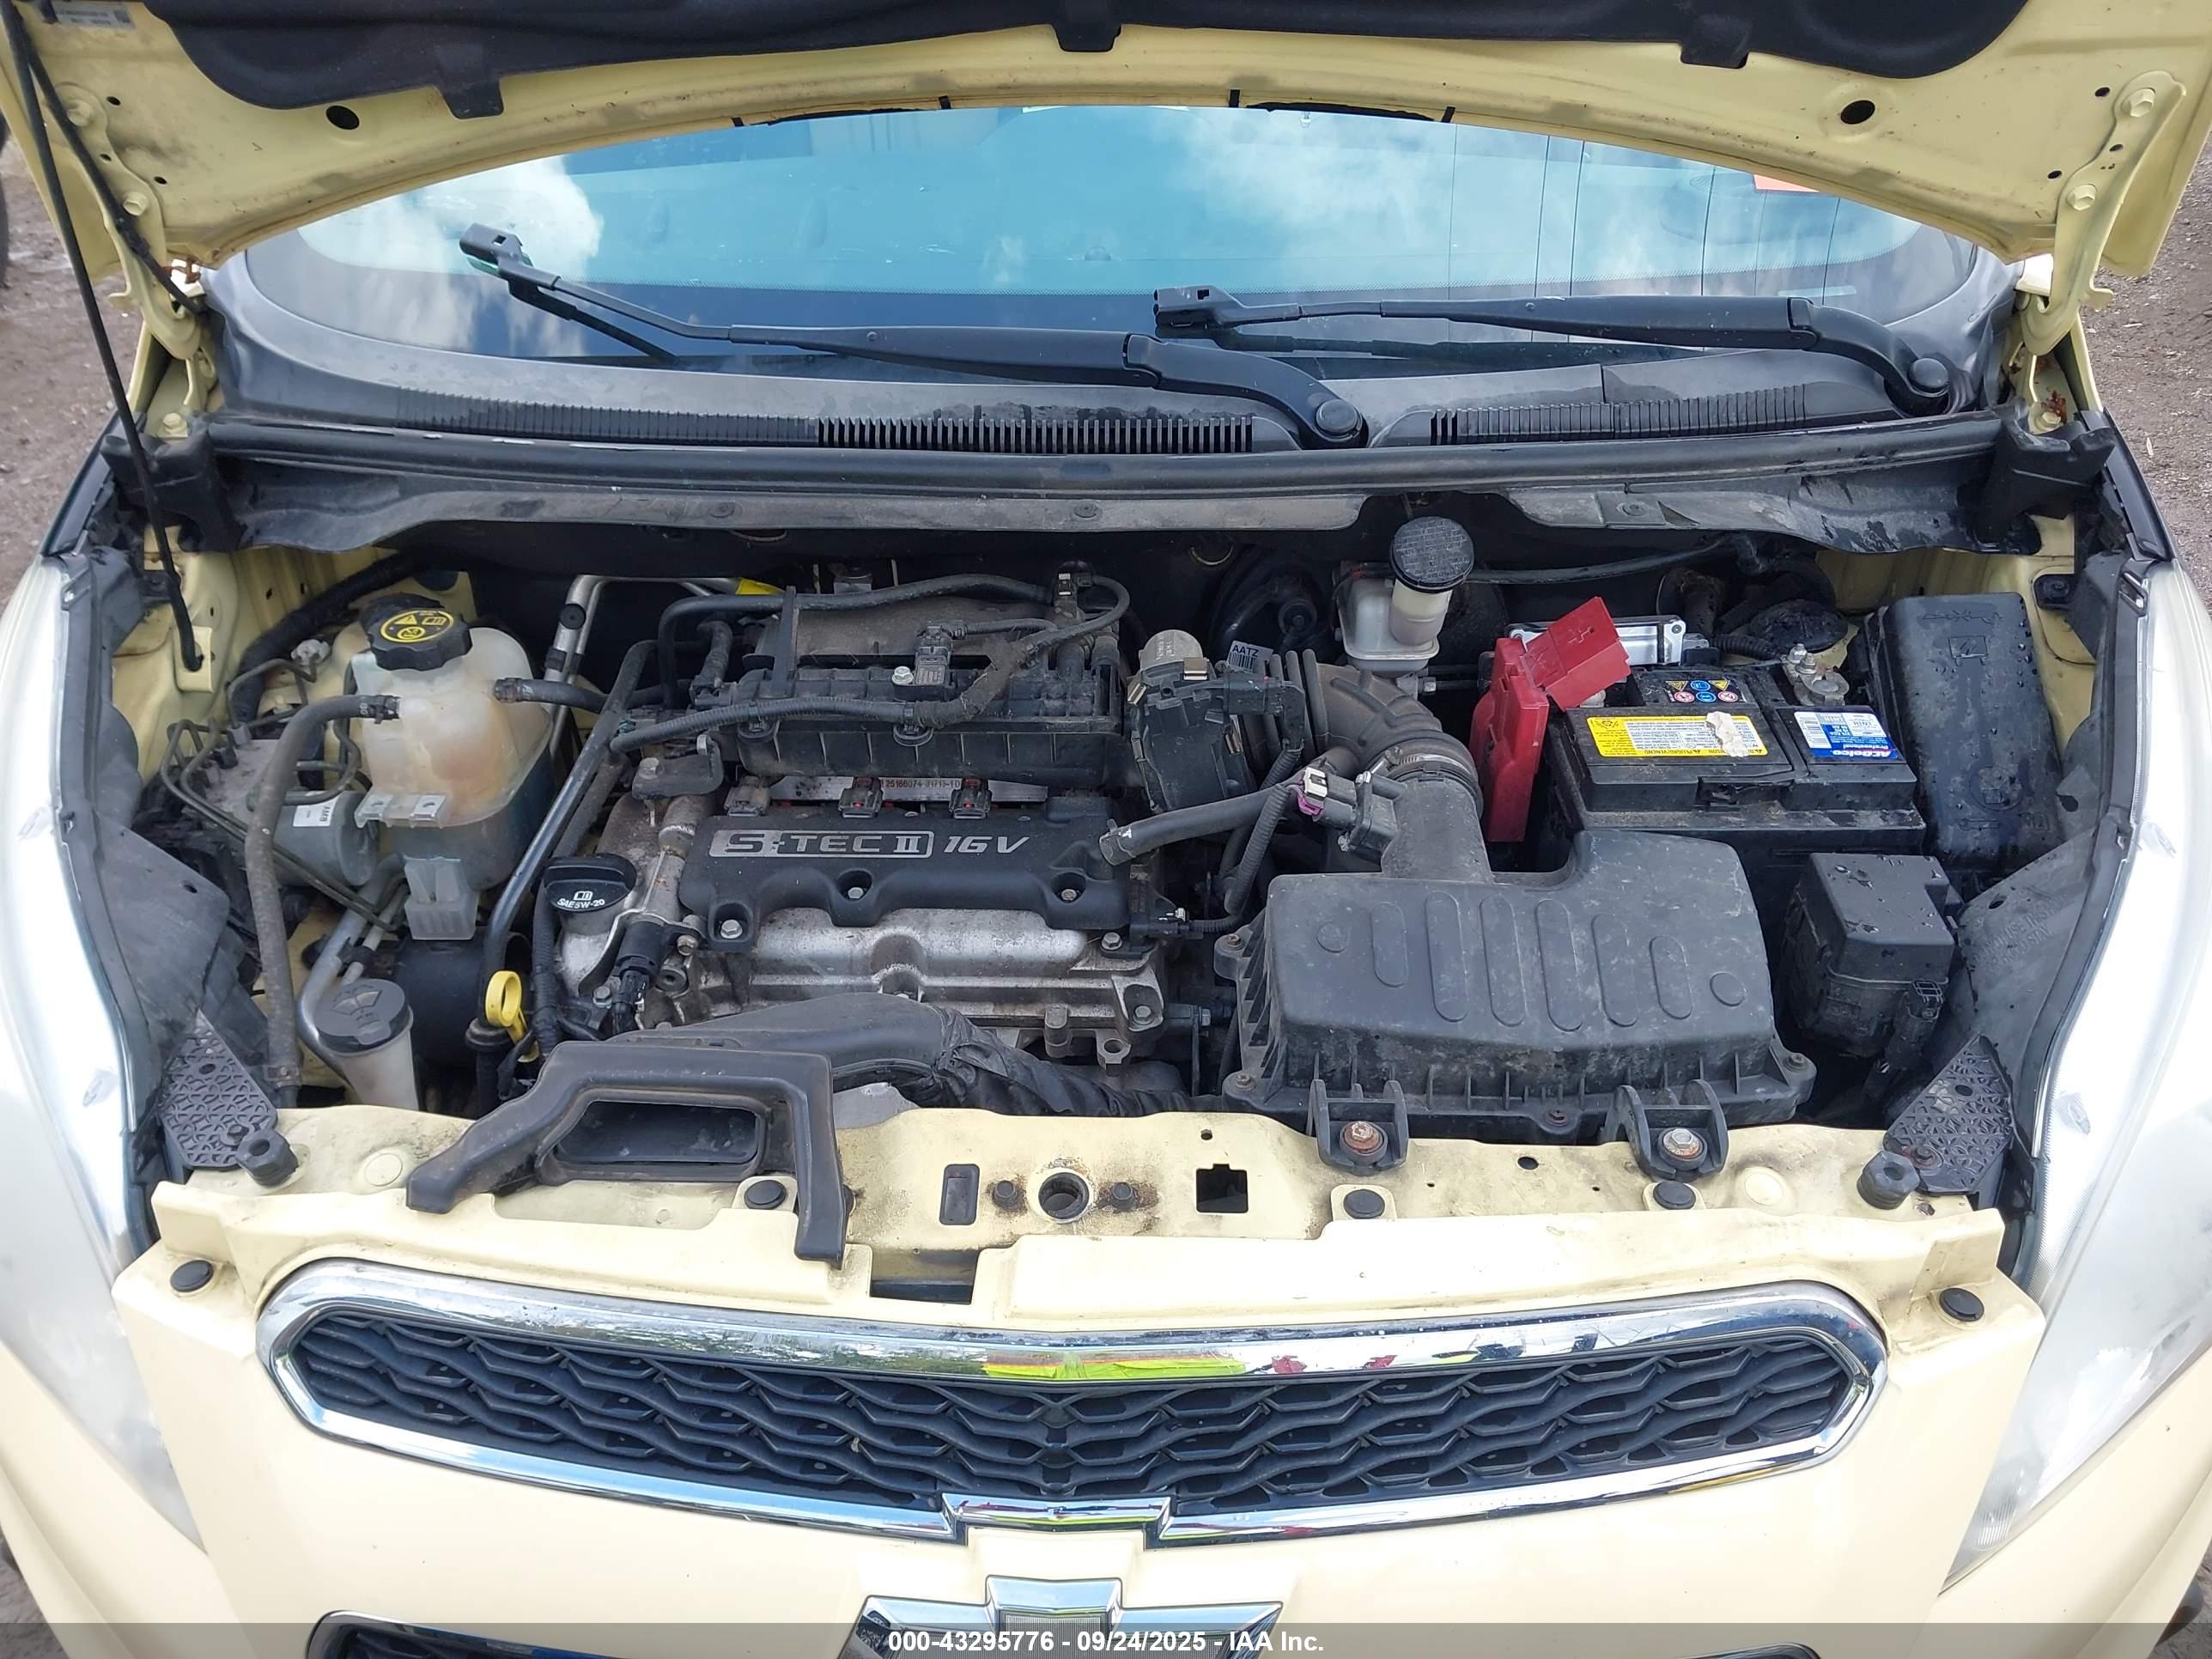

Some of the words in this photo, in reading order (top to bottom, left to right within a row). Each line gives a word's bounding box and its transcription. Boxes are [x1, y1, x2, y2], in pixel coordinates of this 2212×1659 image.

[1231, 644, 1260, 658] AATZ
[1832, 749, 1891, 757] ACDelco
[944, 836, 1030, 854] 16V
